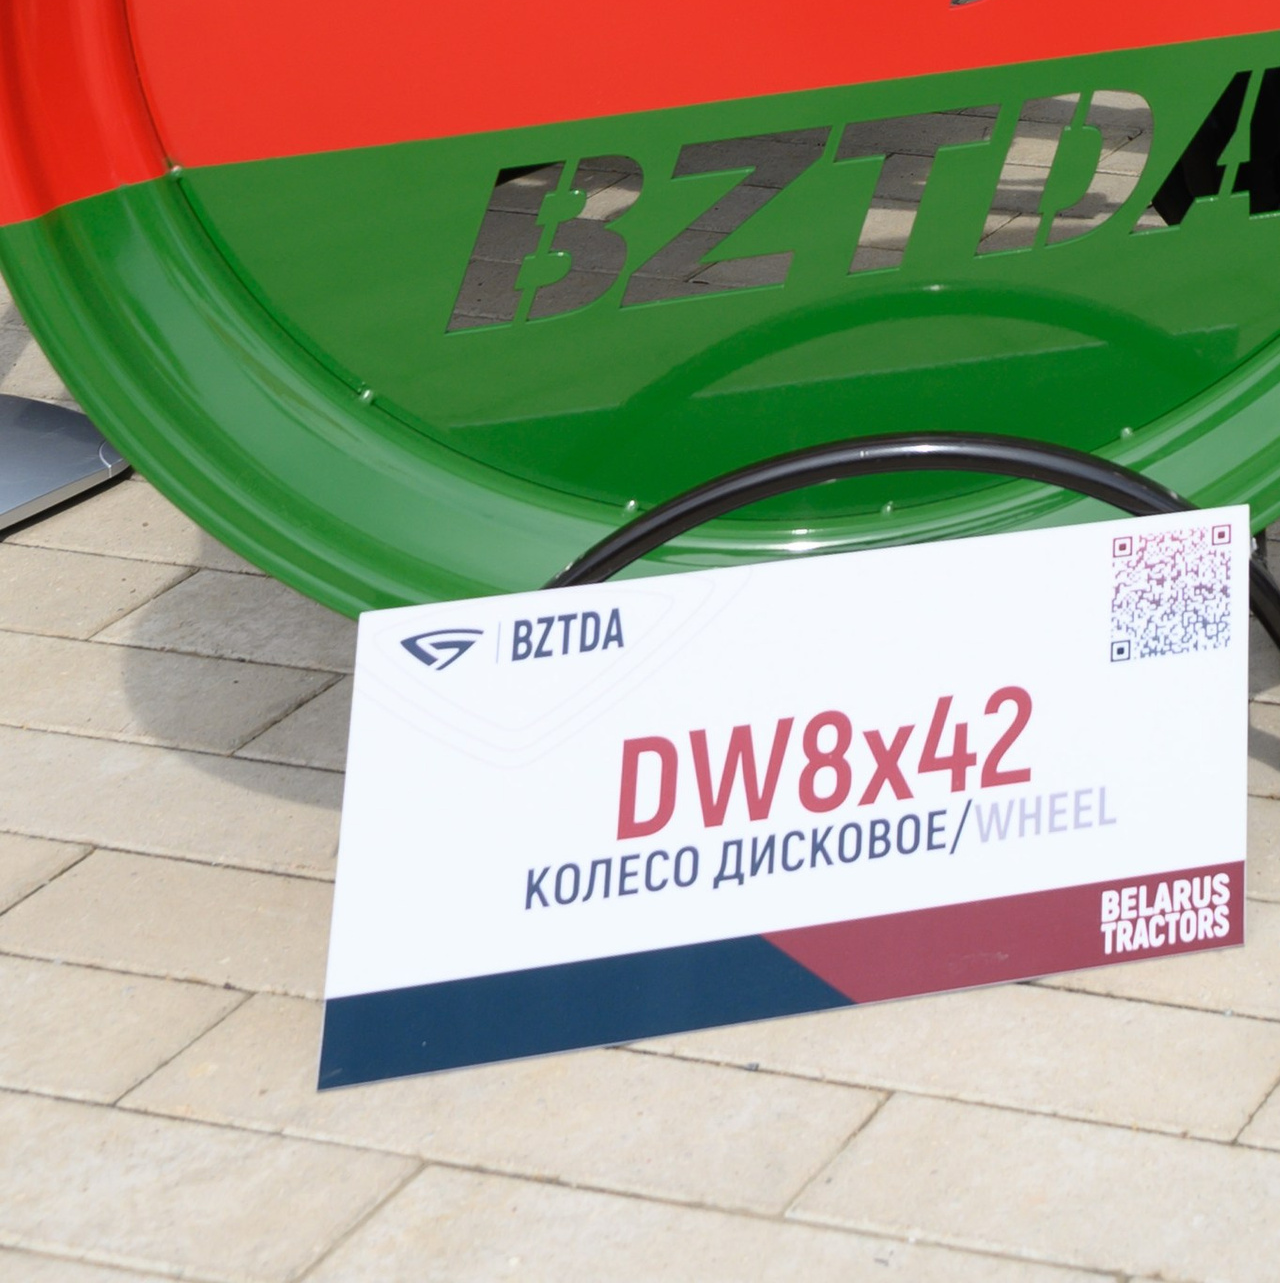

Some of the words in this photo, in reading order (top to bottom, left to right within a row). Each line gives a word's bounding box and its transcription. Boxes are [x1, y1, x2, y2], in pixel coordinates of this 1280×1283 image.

[511, 607, 624, 662] BZTDA
[615, 685, 1034, 840] DW8x42
[524, 846, 699, 911] КОЛЕСО
[712, 785, 1117, 890] ДИСКОВОЕ/WHEEL
[1100, 873, 1231, 923] BELARUS
[1100, 905, 1231, 954] TRACTORS
